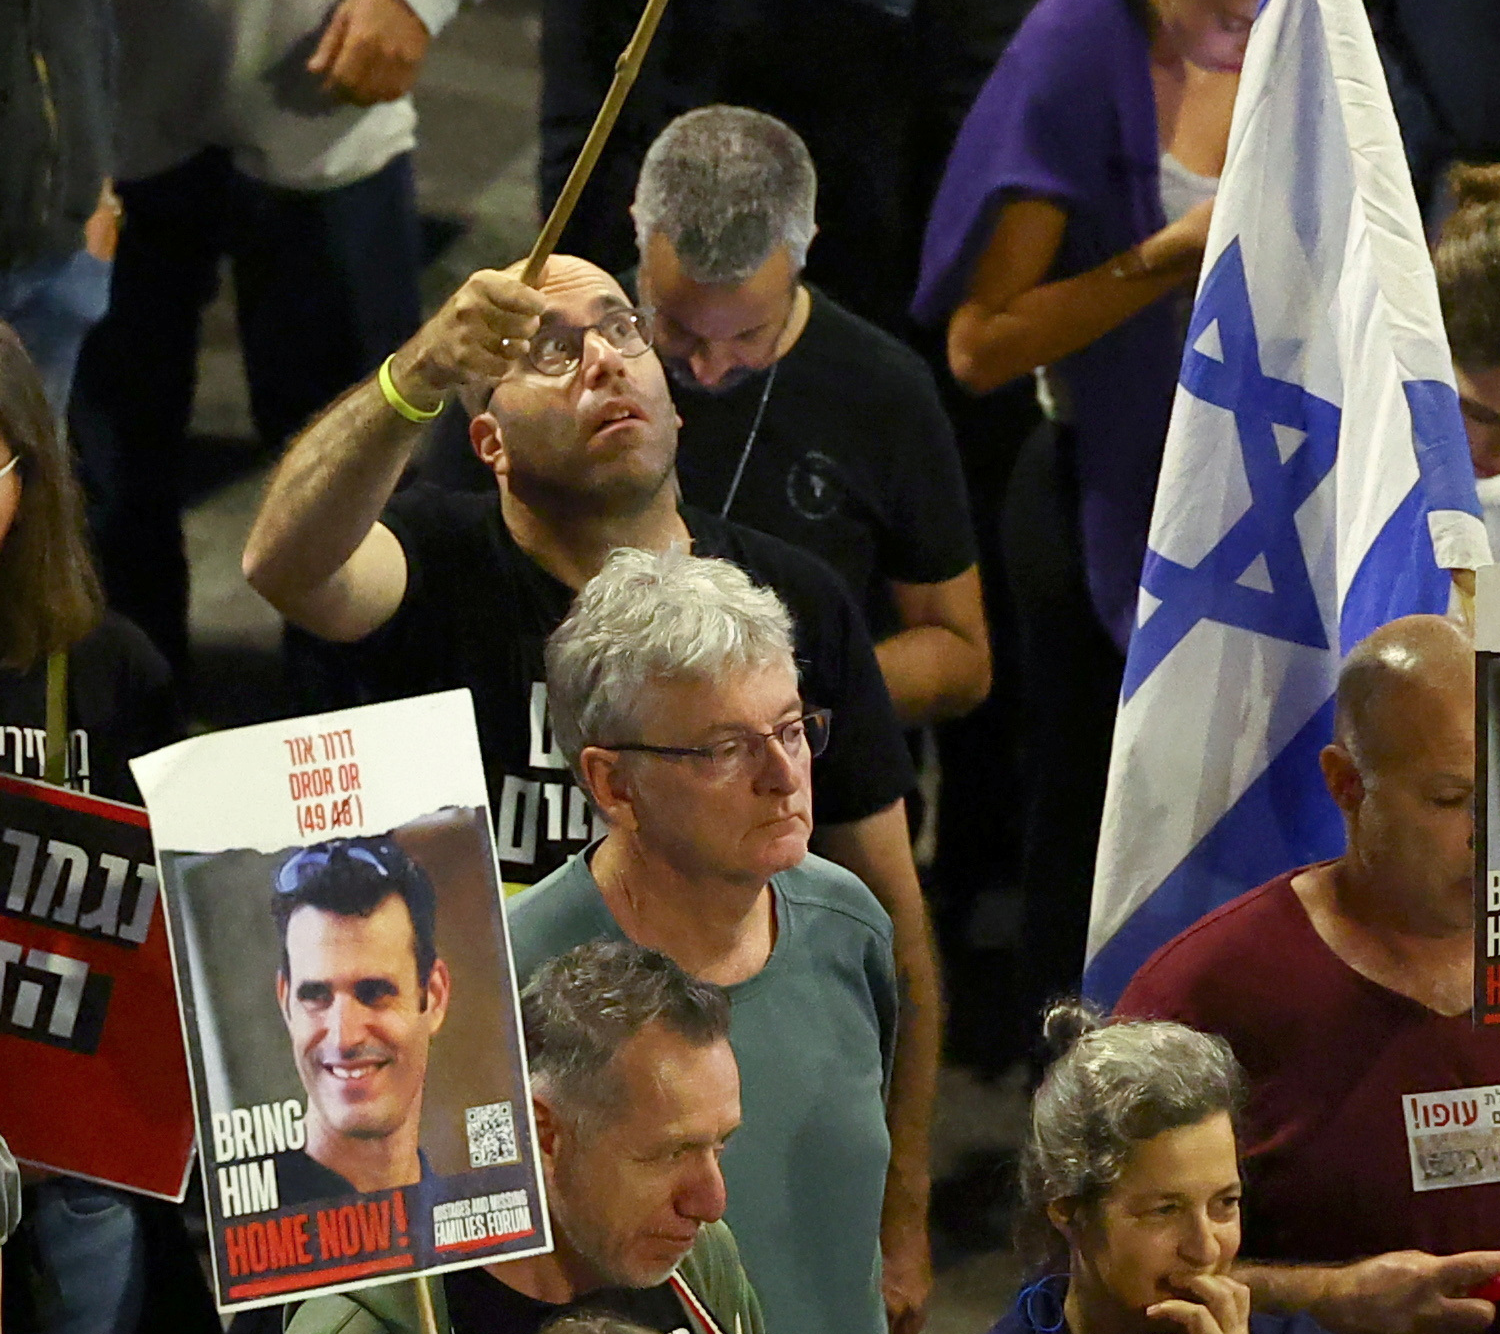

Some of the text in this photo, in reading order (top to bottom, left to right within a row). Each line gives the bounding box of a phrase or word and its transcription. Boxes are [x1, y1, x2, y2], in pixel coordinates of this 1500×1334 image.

[283, 729, 355, 766] דרור אור
[289, 763, 362, 801] DROR OR
[2, 828, 158, 944] נגמר
[211, 1099, 305, 1163] BRING
[1411, 1097, 1478, 1129] עופו!
[217, 1158, 280, 1218] HIM
[224, 1190, 410, 1277] HOME NOW!
[434, 1205, 533, 1247] FAMILIES FORUM
